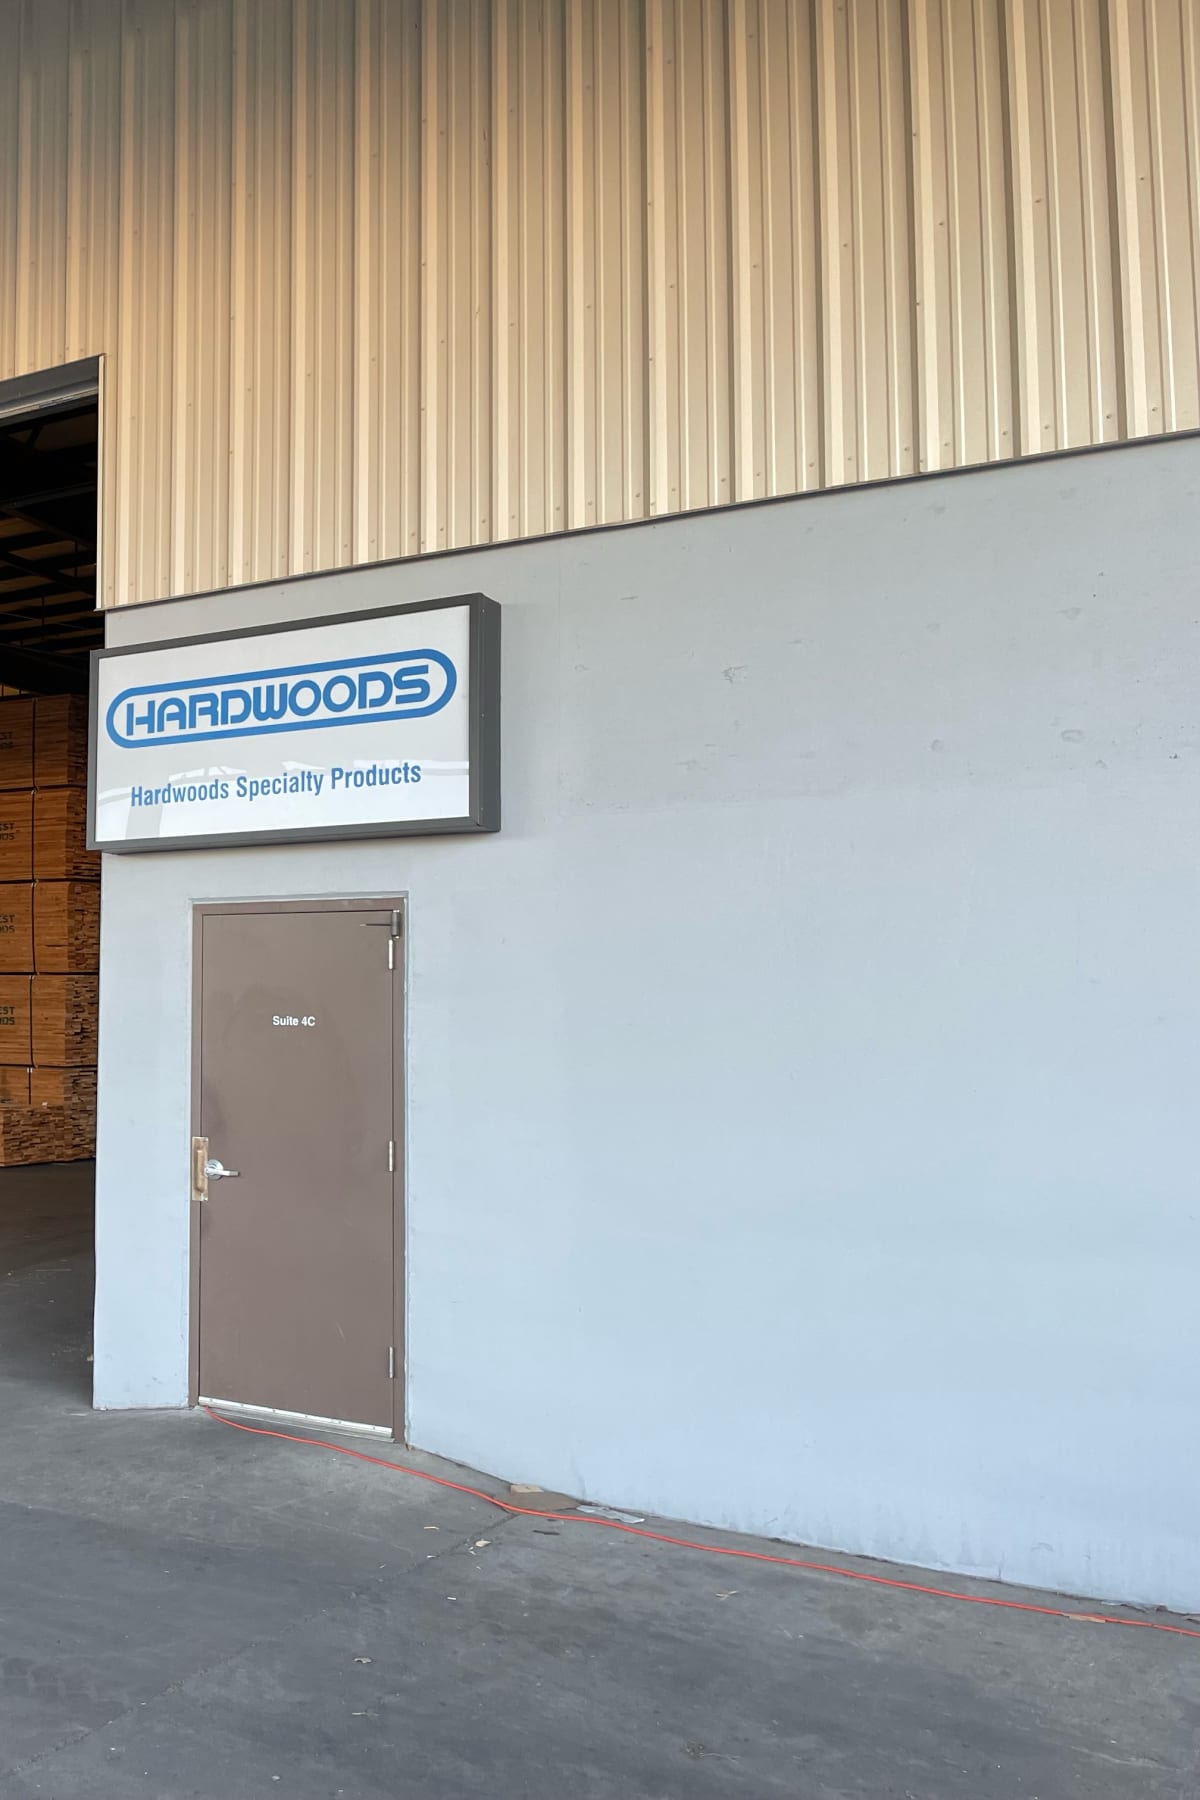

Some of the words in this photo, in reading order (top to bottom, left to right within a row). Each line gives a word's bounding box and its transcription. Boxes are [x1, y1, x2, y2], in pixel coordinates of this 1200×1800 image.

[126, 665, 430, 736] HARDWOODS
[130, 779, 229, 807] Hardwoods
[236, 771, 324, 801] Specialty
[331, 762, 422, 789] Products
[272, 1015, 299, 1026] Suite
[301, 1015, 316, 1027] 4C
